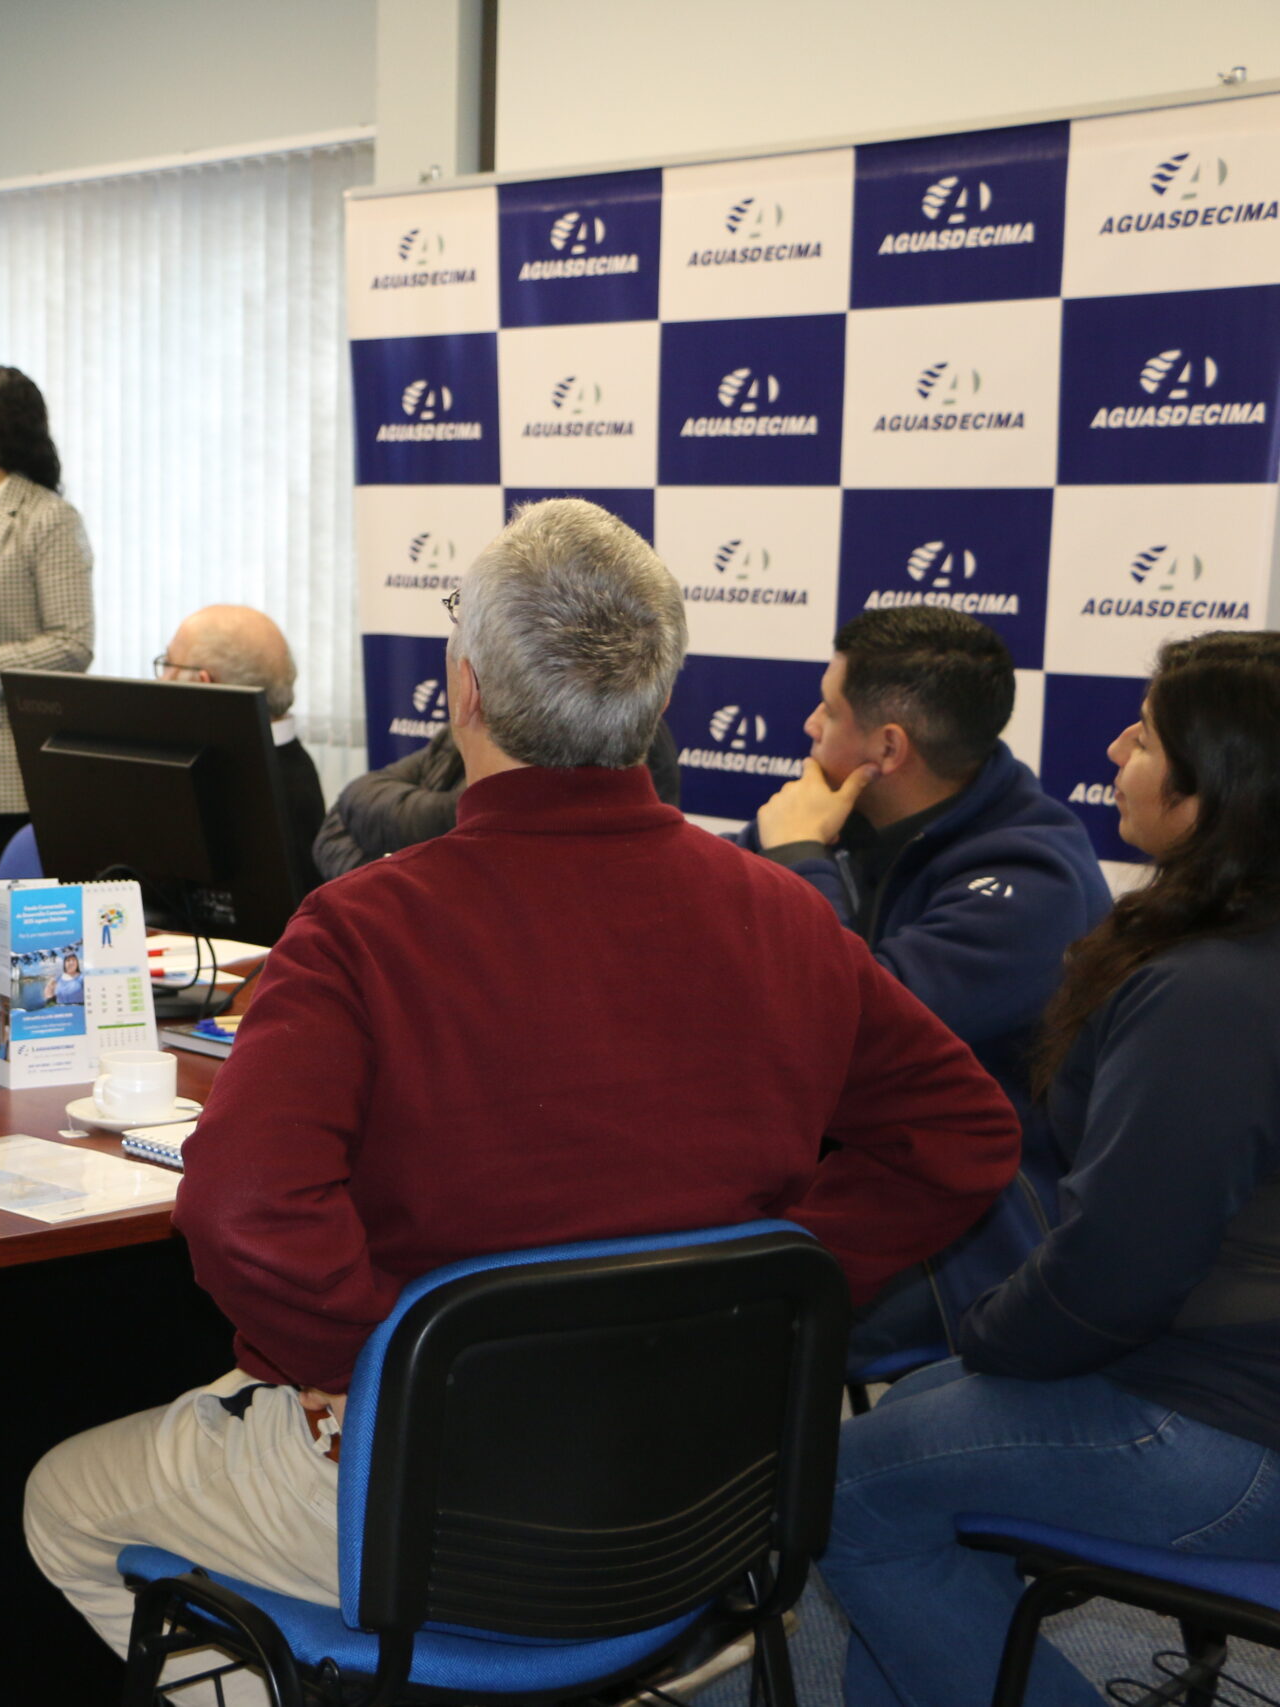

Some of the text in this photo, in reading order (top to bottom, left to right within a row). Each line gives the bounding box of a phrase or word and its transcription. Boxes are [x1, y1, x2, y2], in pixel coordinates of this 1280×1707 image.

[1099, 201, 1279, 235] AGUASDECIMA
[878, 222, 1035, 255] AGUASDECIMA
[687, 242, 823, 267] AGUASDECIMA
[519, 254, 639, 281] AGUASDECIMA
[371, 269, 477, 290] AGUASDECIMA
[680, 415, 818, 437] AGUASDECIMA
[874, 412, 1025, 432] AGUASDECIMA
[1090, 402, 1266, 429] AGUASDECIMA
[376, 422, 482, 442] AGUASDECIMA
[522, 420, 634, 438] AGUASDECIMA
[384, 573, 461, 590] AGUASDEC
[682, 586, 809, 606] AGUASDECIMA
[1081, 597, 1250, 620] AGUASDECIMA
[677, 747, 804, 778] AGUASDECIMA
